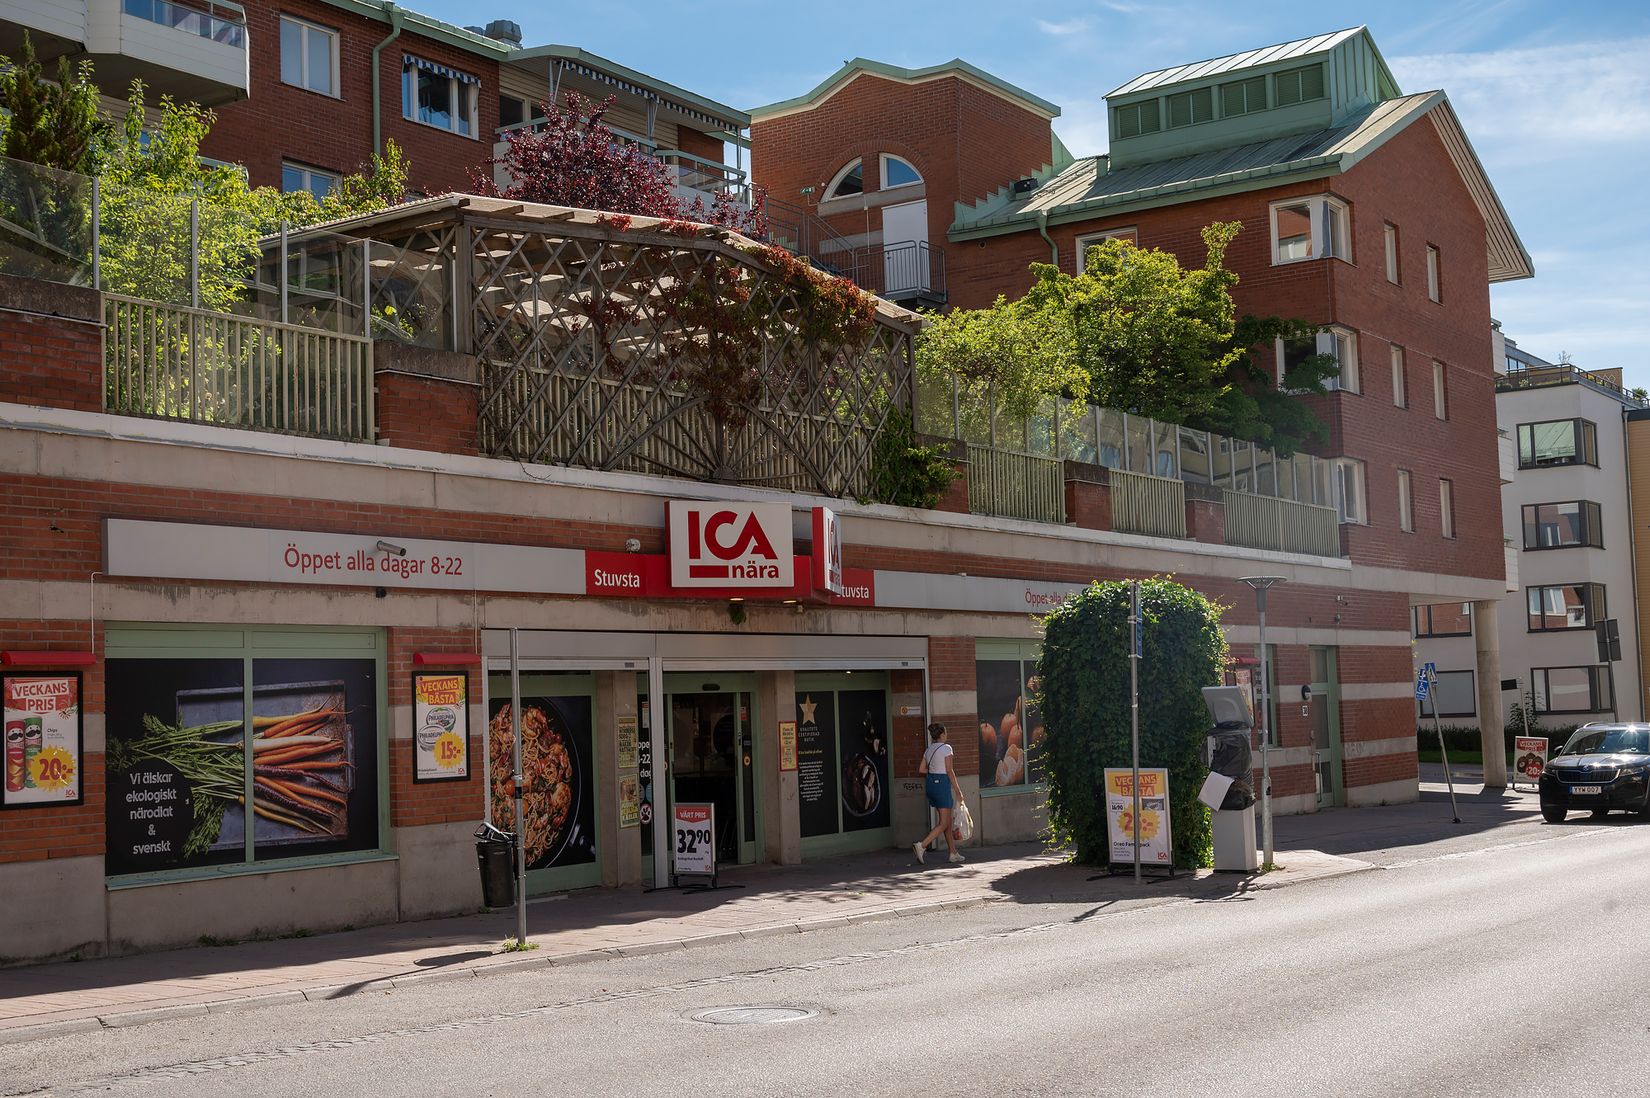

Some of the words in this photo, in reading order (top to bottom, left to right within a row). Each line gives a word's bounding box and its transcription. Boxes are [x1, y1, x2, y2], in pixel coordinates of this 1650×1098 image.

[687, 510, 778, 560] ICA
[284, 543, 341, 574] Öppet
[347, 550, 375, 571] alla
[380, 551, 425, 579] dagar
[430, 556, 462, 576] 8-22
[732, 561, 779, 579] nära
[594, 569, 640, 588] Stuvsta
[837, 586, 869, 599] tuvsta
[1025, 588, 1048, 606] Öppet
[1049, 592, 1062, 604] alla
[15, 682, 68, 697] VECKANS
[421, 679, 458, 692] VECKANS
[28, 698, 55, 711] PRIS
[428, 692, 456, 704] BÄSTA
[441, 741, 461, 760] 15:-
[129, 772, 141, 785] Vi
[142, 772, 173, 784] älskar
[1115, 775, 1156, 786] VECANS
[126, 788, 177, 803] ekologiskt
[129, 806, 173, 820] närodlat
[680, 810, 694, 818] VÅRT
[694, 811, 706, 819] PRIS
[147, 824, 156, 836] &
[132, 840, 171, 855] svenskt
